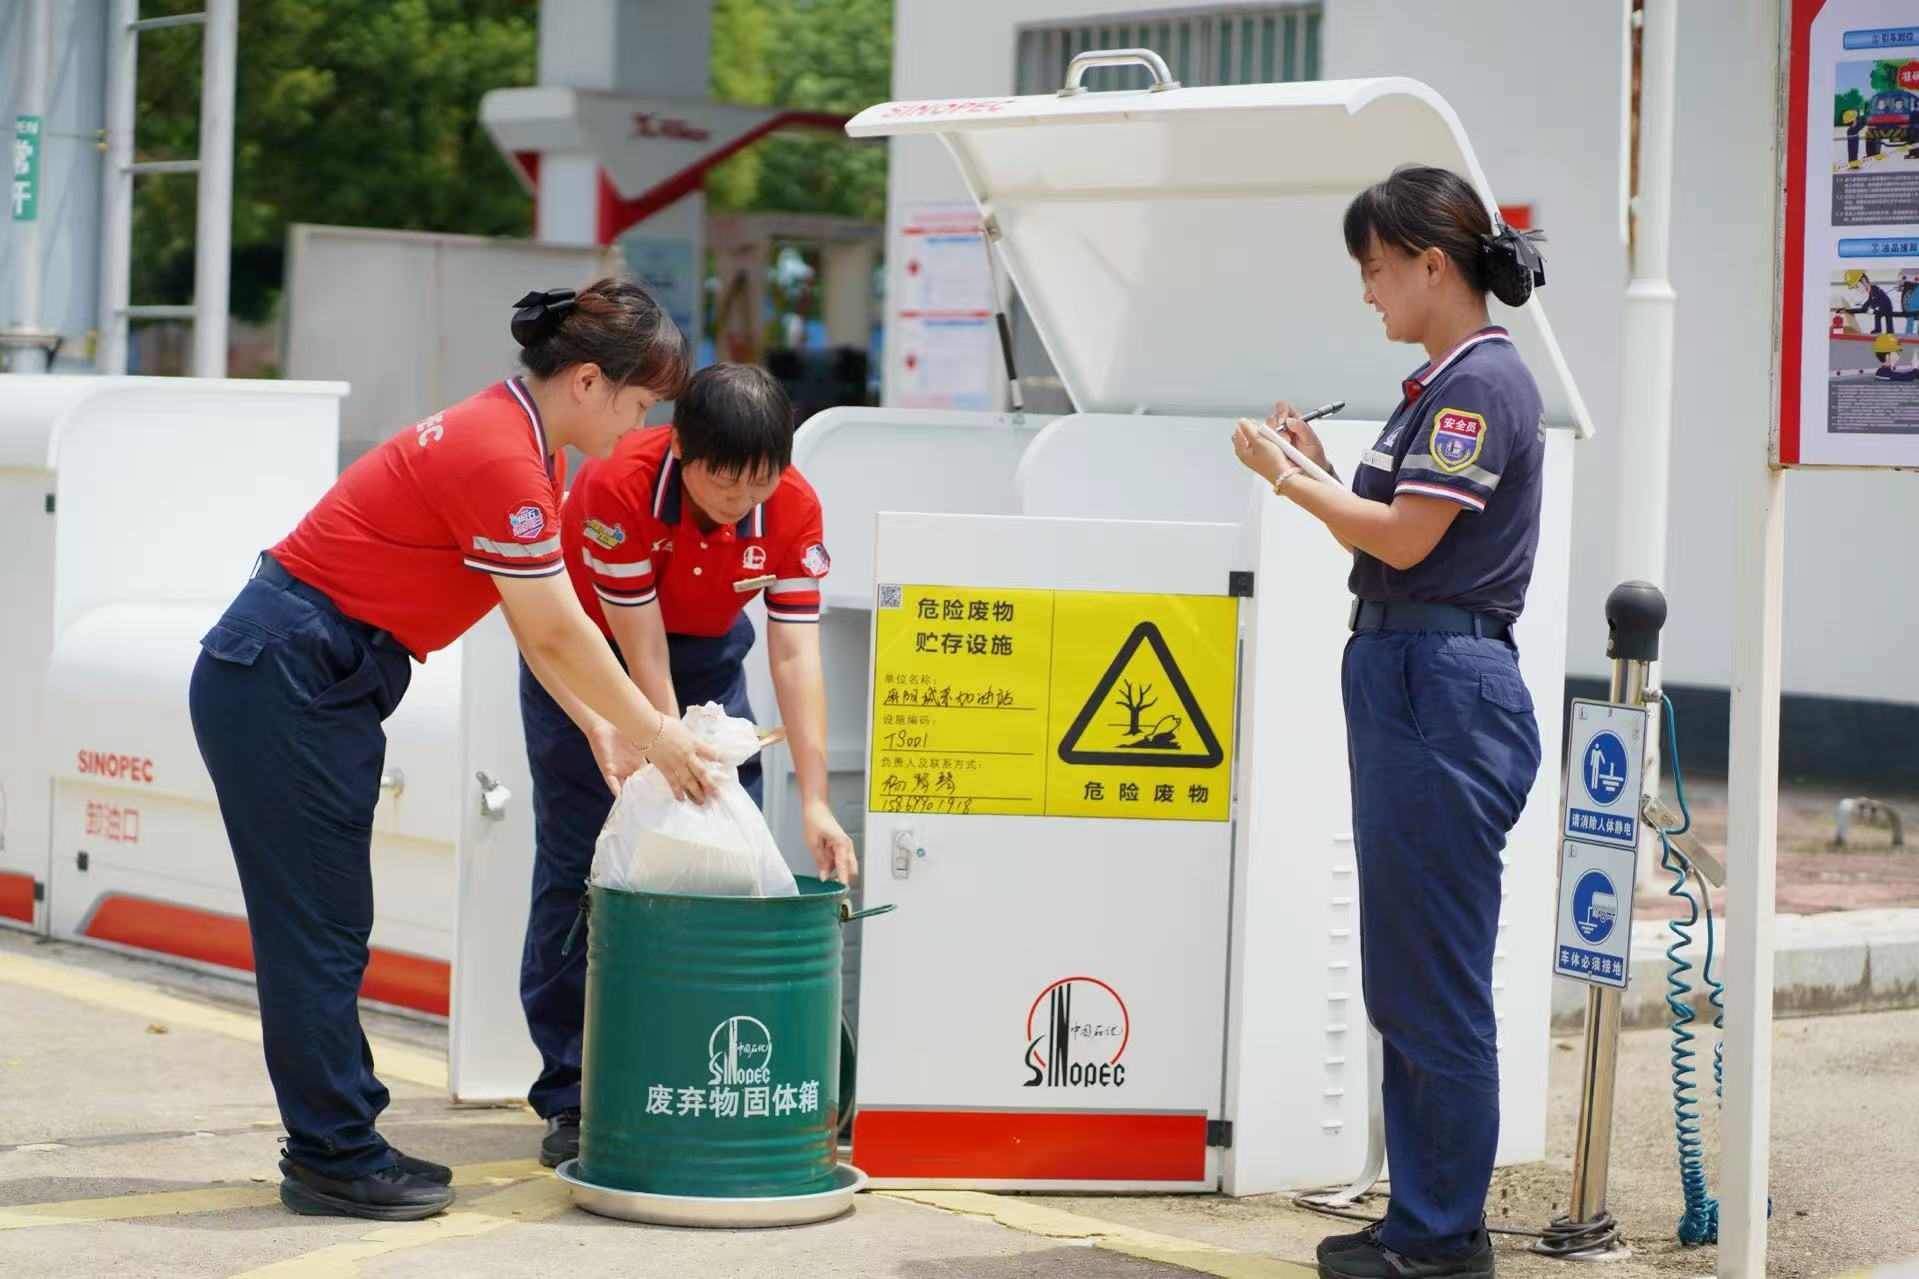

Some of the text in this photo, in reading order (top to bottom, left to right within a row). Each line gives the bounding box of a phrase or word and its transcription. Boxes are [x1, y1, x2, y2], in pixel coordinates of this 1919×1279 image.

[1443, 417, 1477, 433] 安全员
[917, 597, 1014, 622] 危险废物
[915, 631, 1013, 656] 贮存设施
[78, 749, 155, 783] SINOPEC
[1083, 780, 1209, 803] 危险废物
[1571, 813, 1632, 836] 请消除人体静电
[1560, 950, 1622, 977] 车体必须接地
[645, 1079, 820, 1118] 废弃物固体箱
